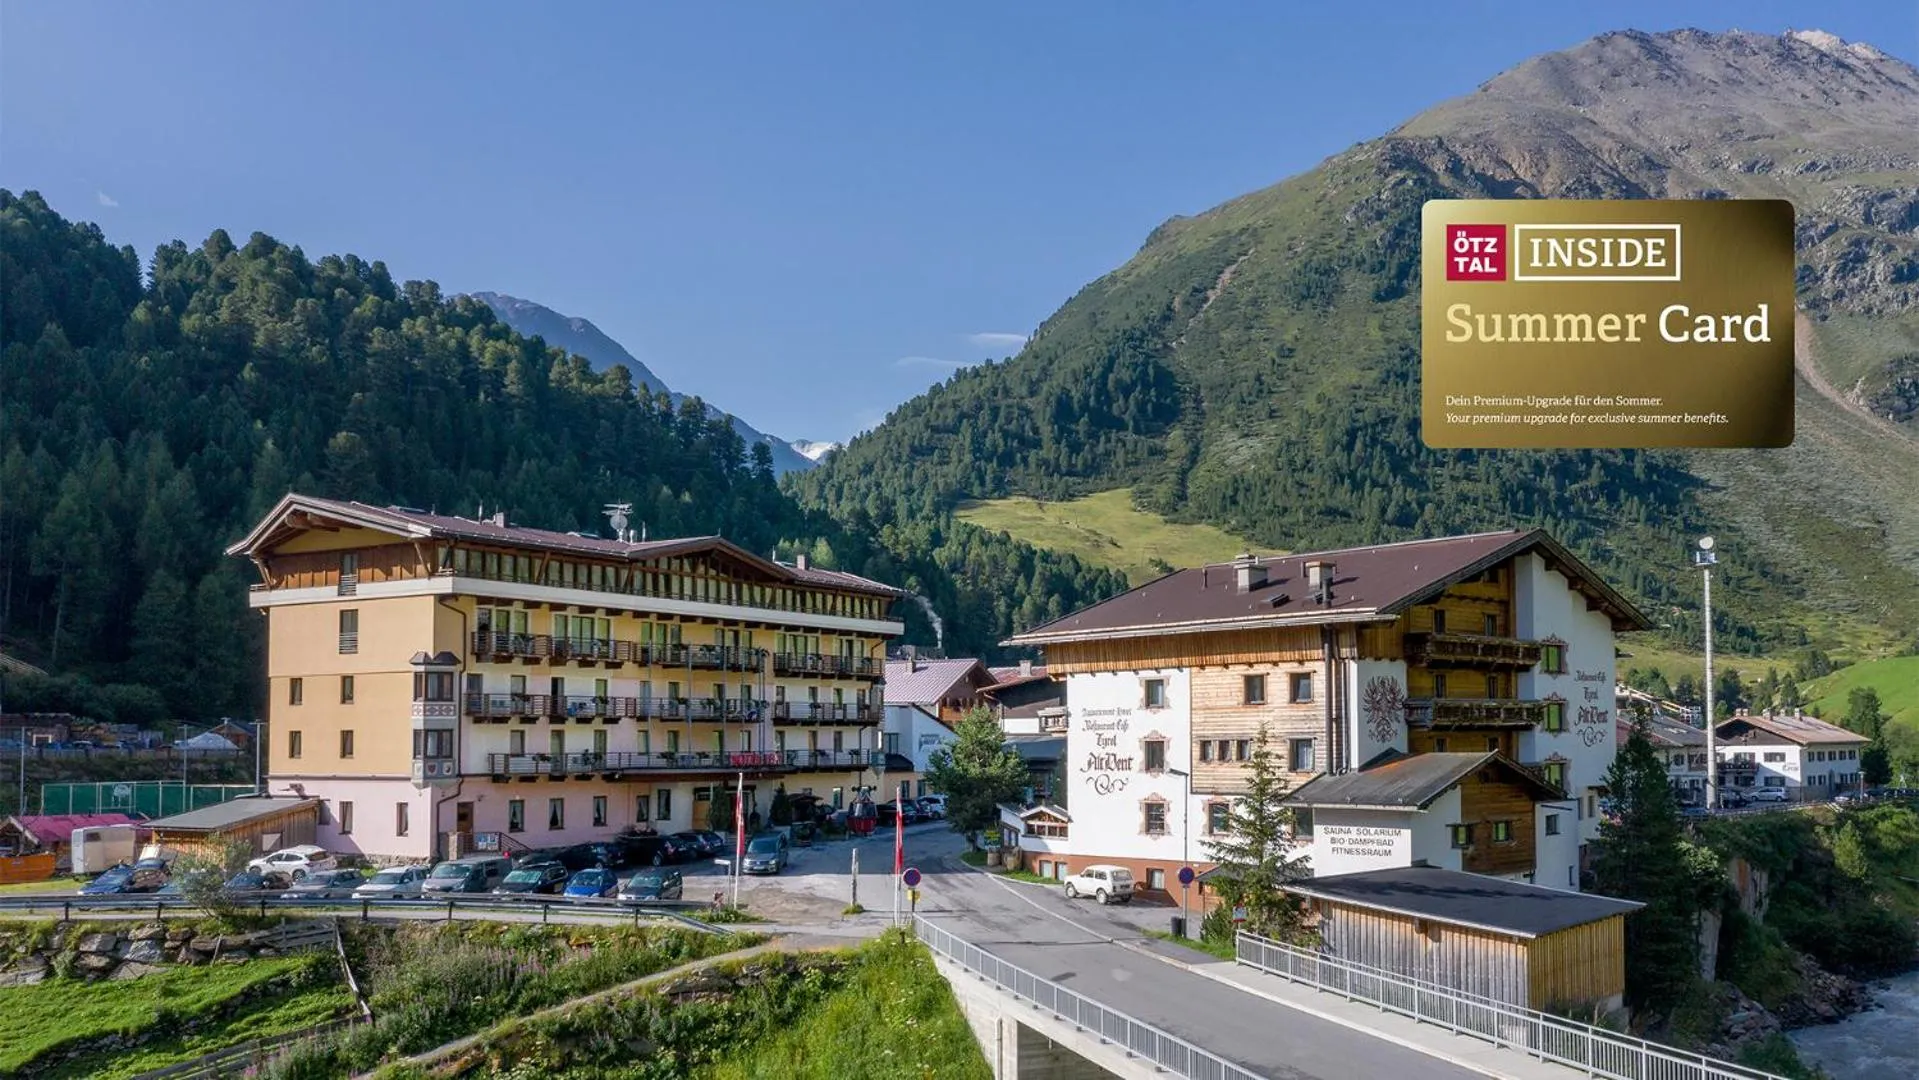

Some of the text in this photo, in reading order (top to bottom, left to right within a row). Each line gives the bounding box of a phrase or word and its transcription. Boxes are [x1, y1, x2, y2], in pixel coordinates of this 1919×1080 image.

[1096, 733, 1116, 749] Tyrol
[1324, 826, 1402, 837] SAUNA SOLARIUM
[1332, 846, 1392, 857] FITNESSRAUM
